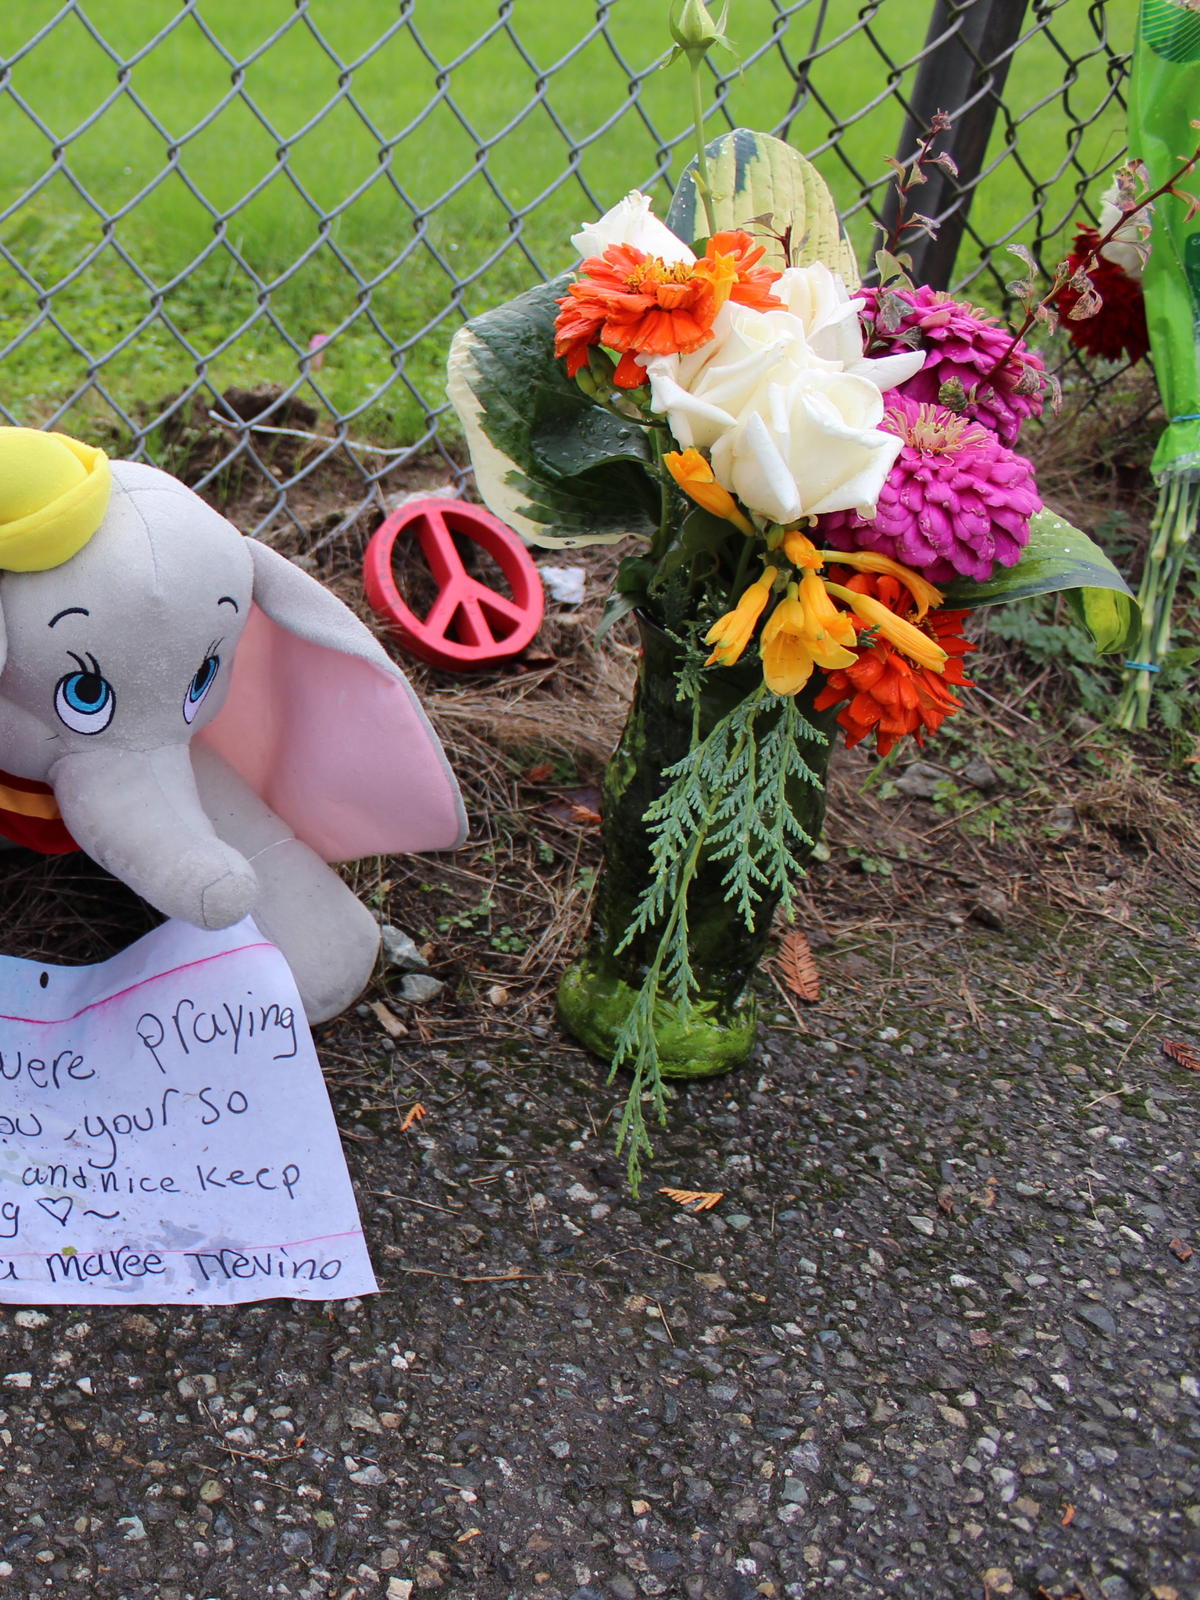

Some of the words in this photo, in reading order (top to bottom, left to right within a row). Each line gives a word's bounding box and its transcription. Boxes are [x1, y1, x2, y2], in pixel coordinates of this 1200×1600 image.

[198, 1087, 249, 1125] so
[101, 1170, 181, 1194] nice
[184, 1247, 342, 1281] Trevino
